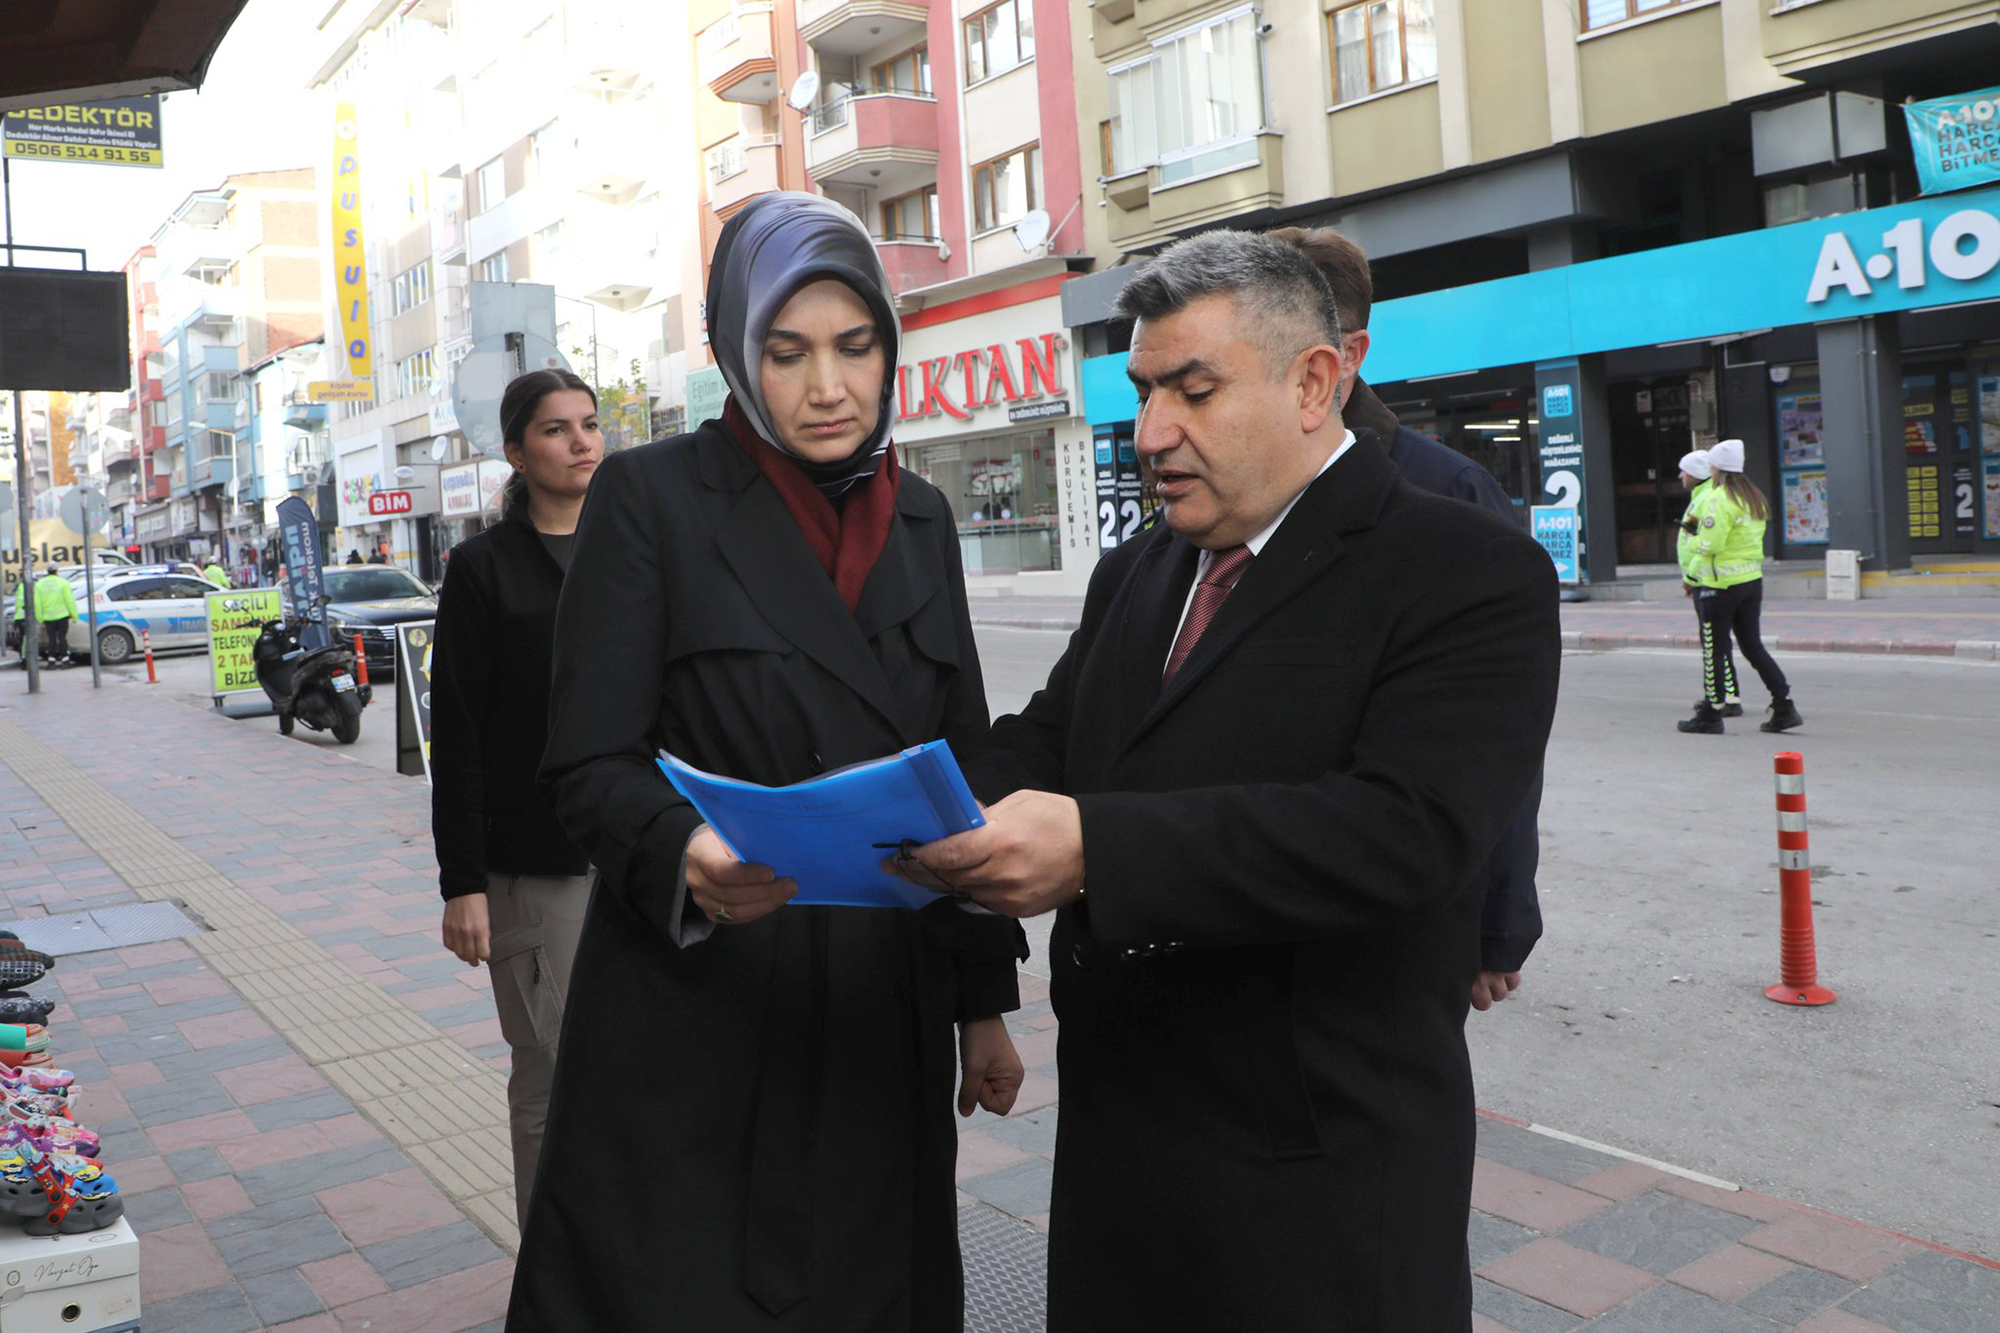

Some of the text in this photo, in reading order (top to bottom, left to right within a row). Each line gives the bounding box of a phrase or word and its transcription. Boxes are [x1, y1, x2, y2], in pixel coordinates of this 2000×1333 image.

[6, 131, 41, 140] Dedektör
[88, 137, 111, 145] Zemin
[112, 138, 134, 147] Etüdü
[28, 123, 42, 131] Her
[43, 124, 66, 133] Marka
[67, 125, 89, 135] Model
[107, 127, 127, 138] İkinci
[15, 142, 150, 162] 0506 514 91 55
[892, 333, 1064, 423] LKTAN
[372, 492, 409, 512] BİM
[1956, 483, 1974, 518] 2
[1098, 500, 1118, 548] 2
[1537, 531, 1572, 541] HARCA
[218, 655, 226, 669] 2
